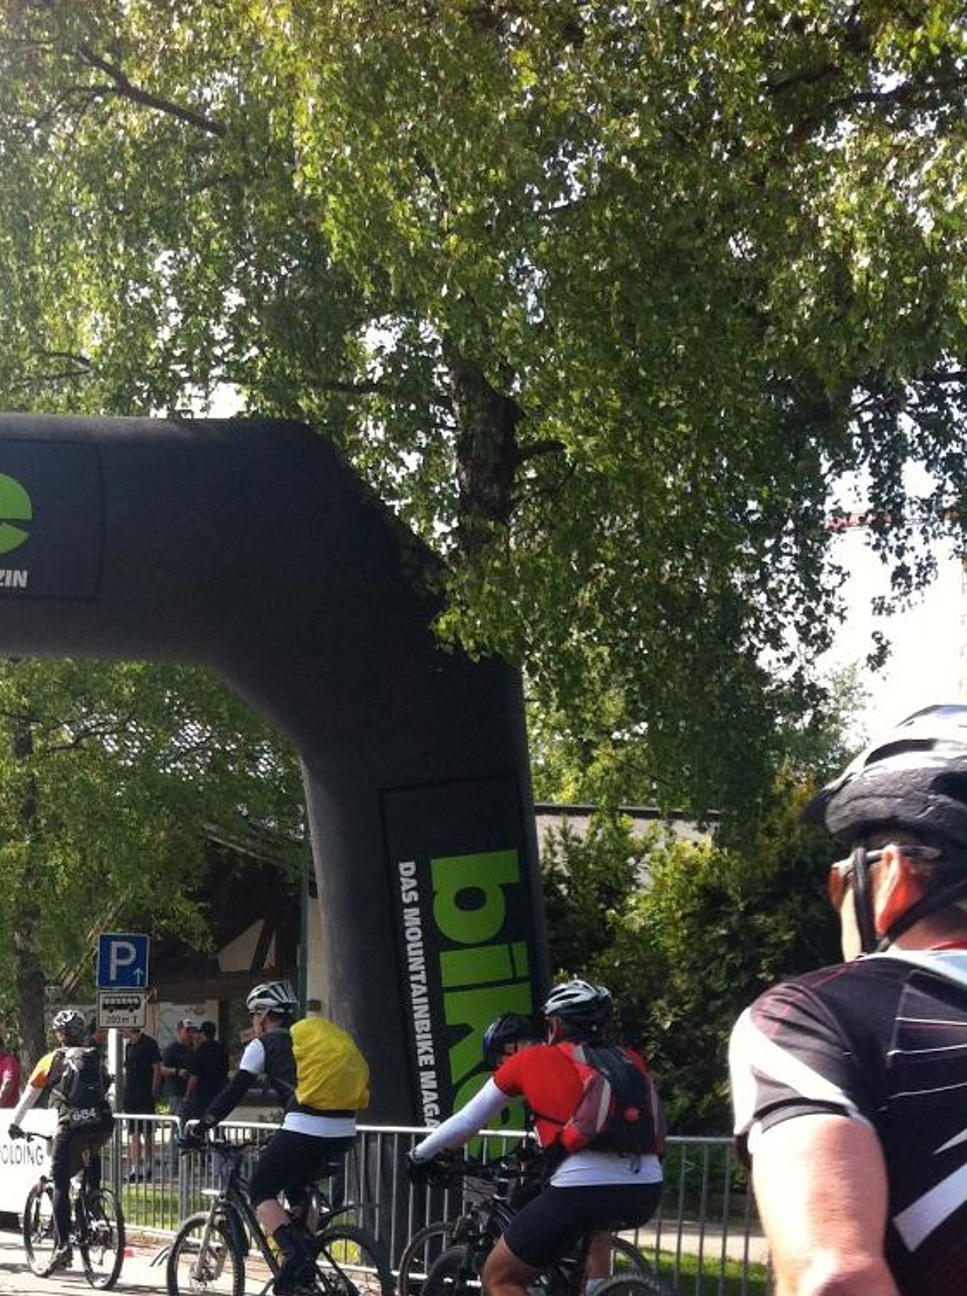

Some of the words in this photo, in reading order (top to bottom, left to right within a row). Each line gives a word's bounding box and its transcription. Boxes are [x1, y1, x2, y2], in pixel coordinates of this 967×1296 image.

[398, 861, 419, 904] DAS
[110, 941, 137, 981] P
[403, 907, 435, 1067] MOUNTAINBIKE
